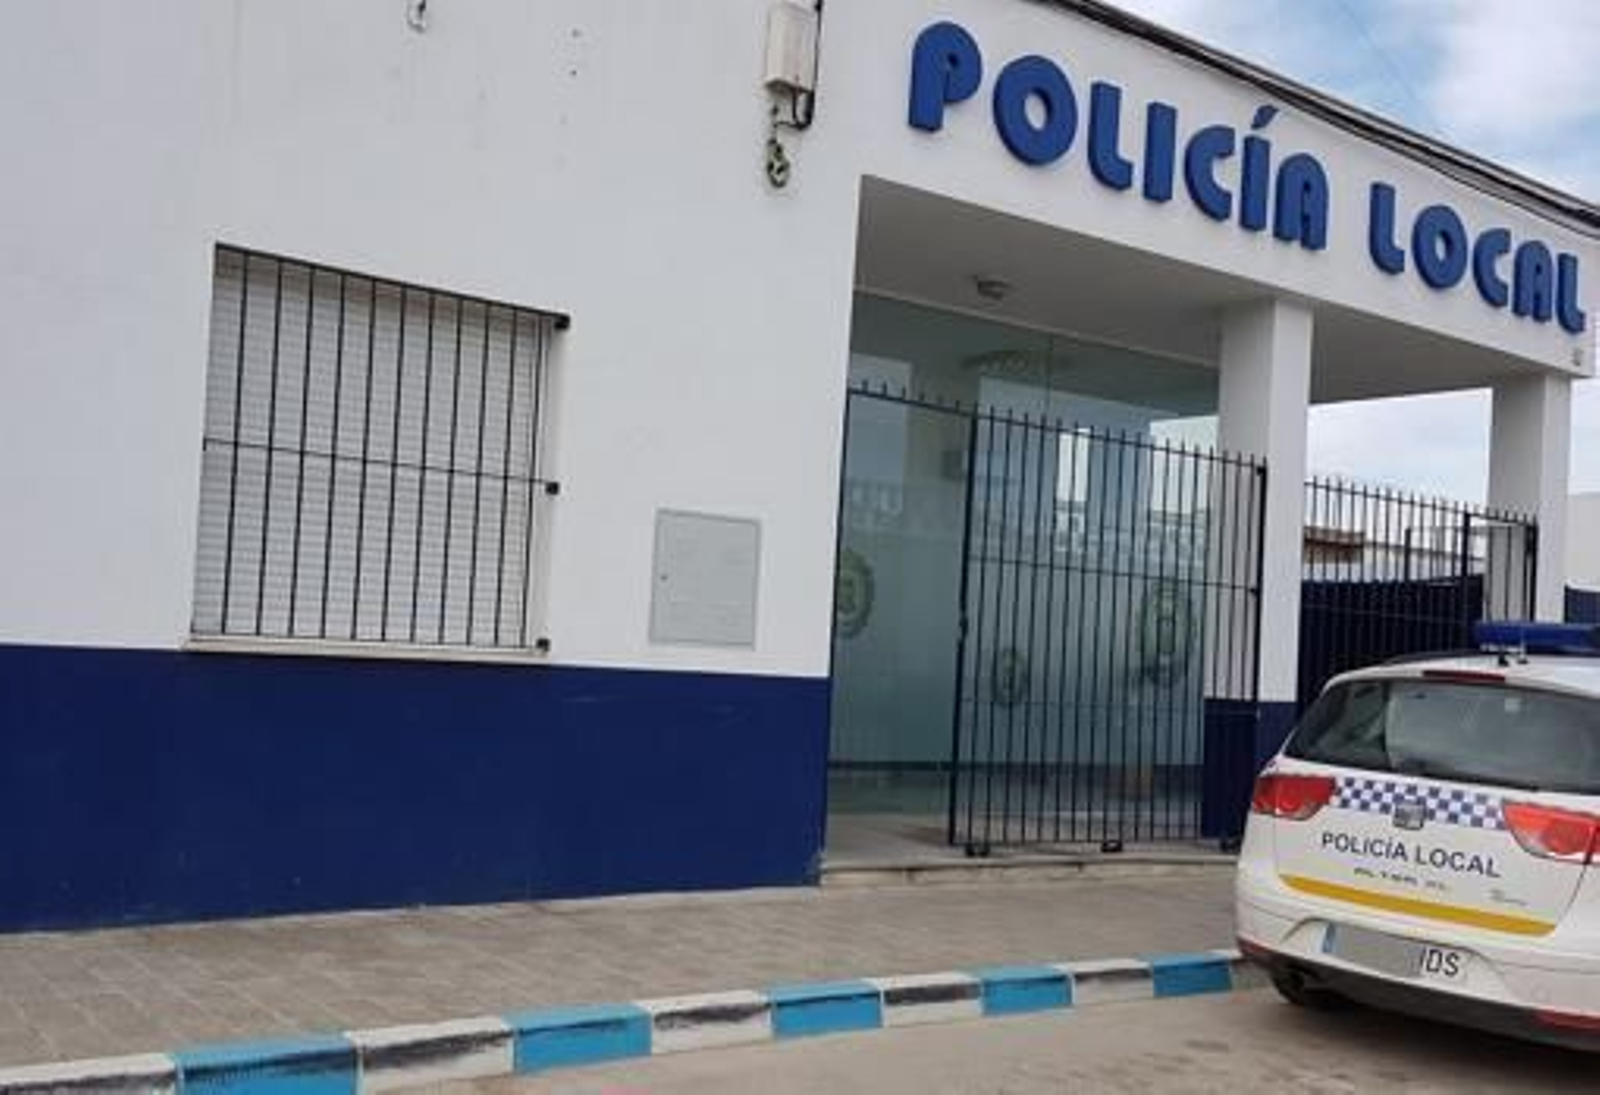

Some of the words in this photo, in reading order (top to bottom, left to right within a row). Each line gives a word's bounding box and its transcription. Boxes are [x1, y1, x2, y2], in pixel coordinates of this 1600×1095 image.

[908, 21, 1329, 250] POLICÍA
[1369, 182, 1586, 334] LOCAL
[1322, 832, 1408, 862] POLICÍA
[1416, 845, 1501, 878] LOCAL
